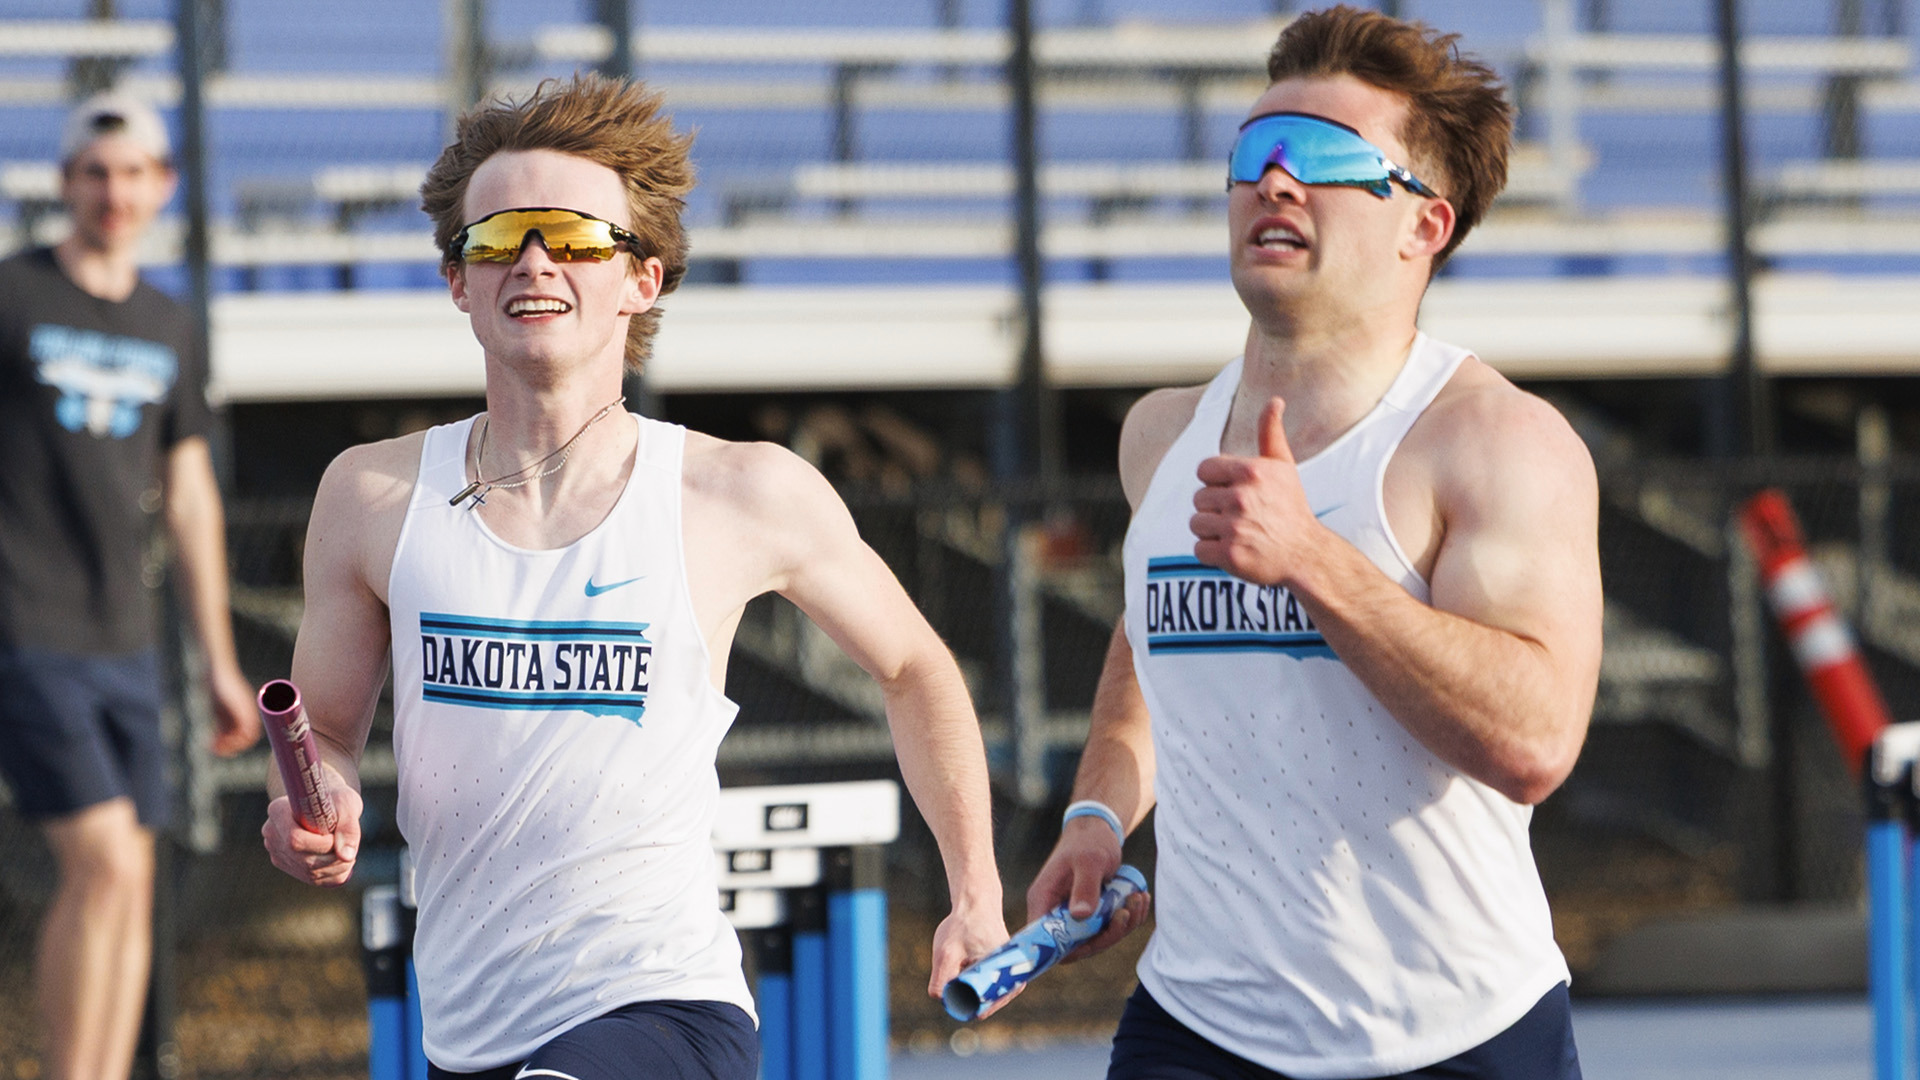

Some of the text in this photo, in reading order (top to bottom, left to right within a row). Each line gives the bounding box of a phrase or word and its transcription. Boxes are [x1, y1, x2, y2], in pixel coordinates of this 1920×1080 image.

[1147, 580, 1316, 632] DAKOTA STA
[421, 635, 652, 692] DAKOTA STATE
